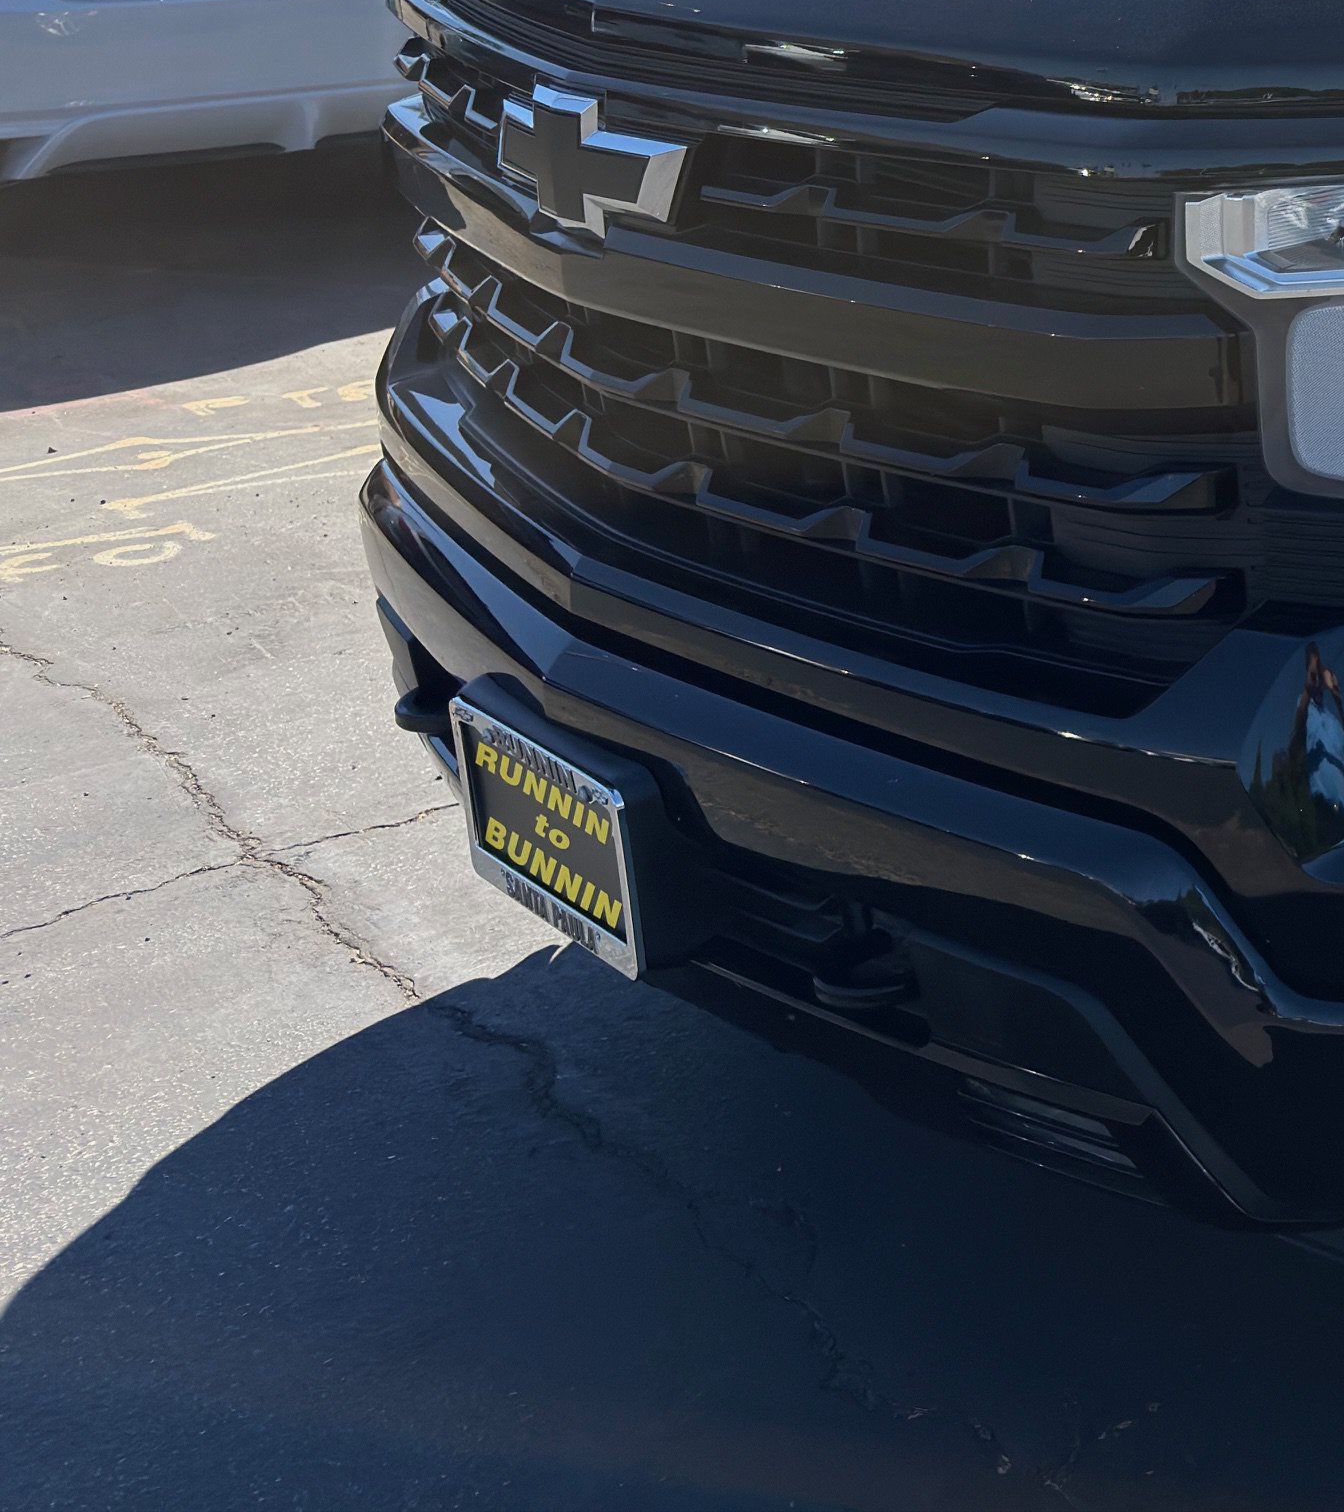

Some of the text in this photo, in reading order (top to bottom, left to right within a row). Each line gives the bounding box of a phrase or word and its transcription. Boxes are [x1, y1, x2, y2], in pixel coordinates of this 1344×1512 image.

[475, 741, 610, 845] RUNNIN
[534, 813, 571, 851] to
[485, 816, 623, 929] BUNNIN
